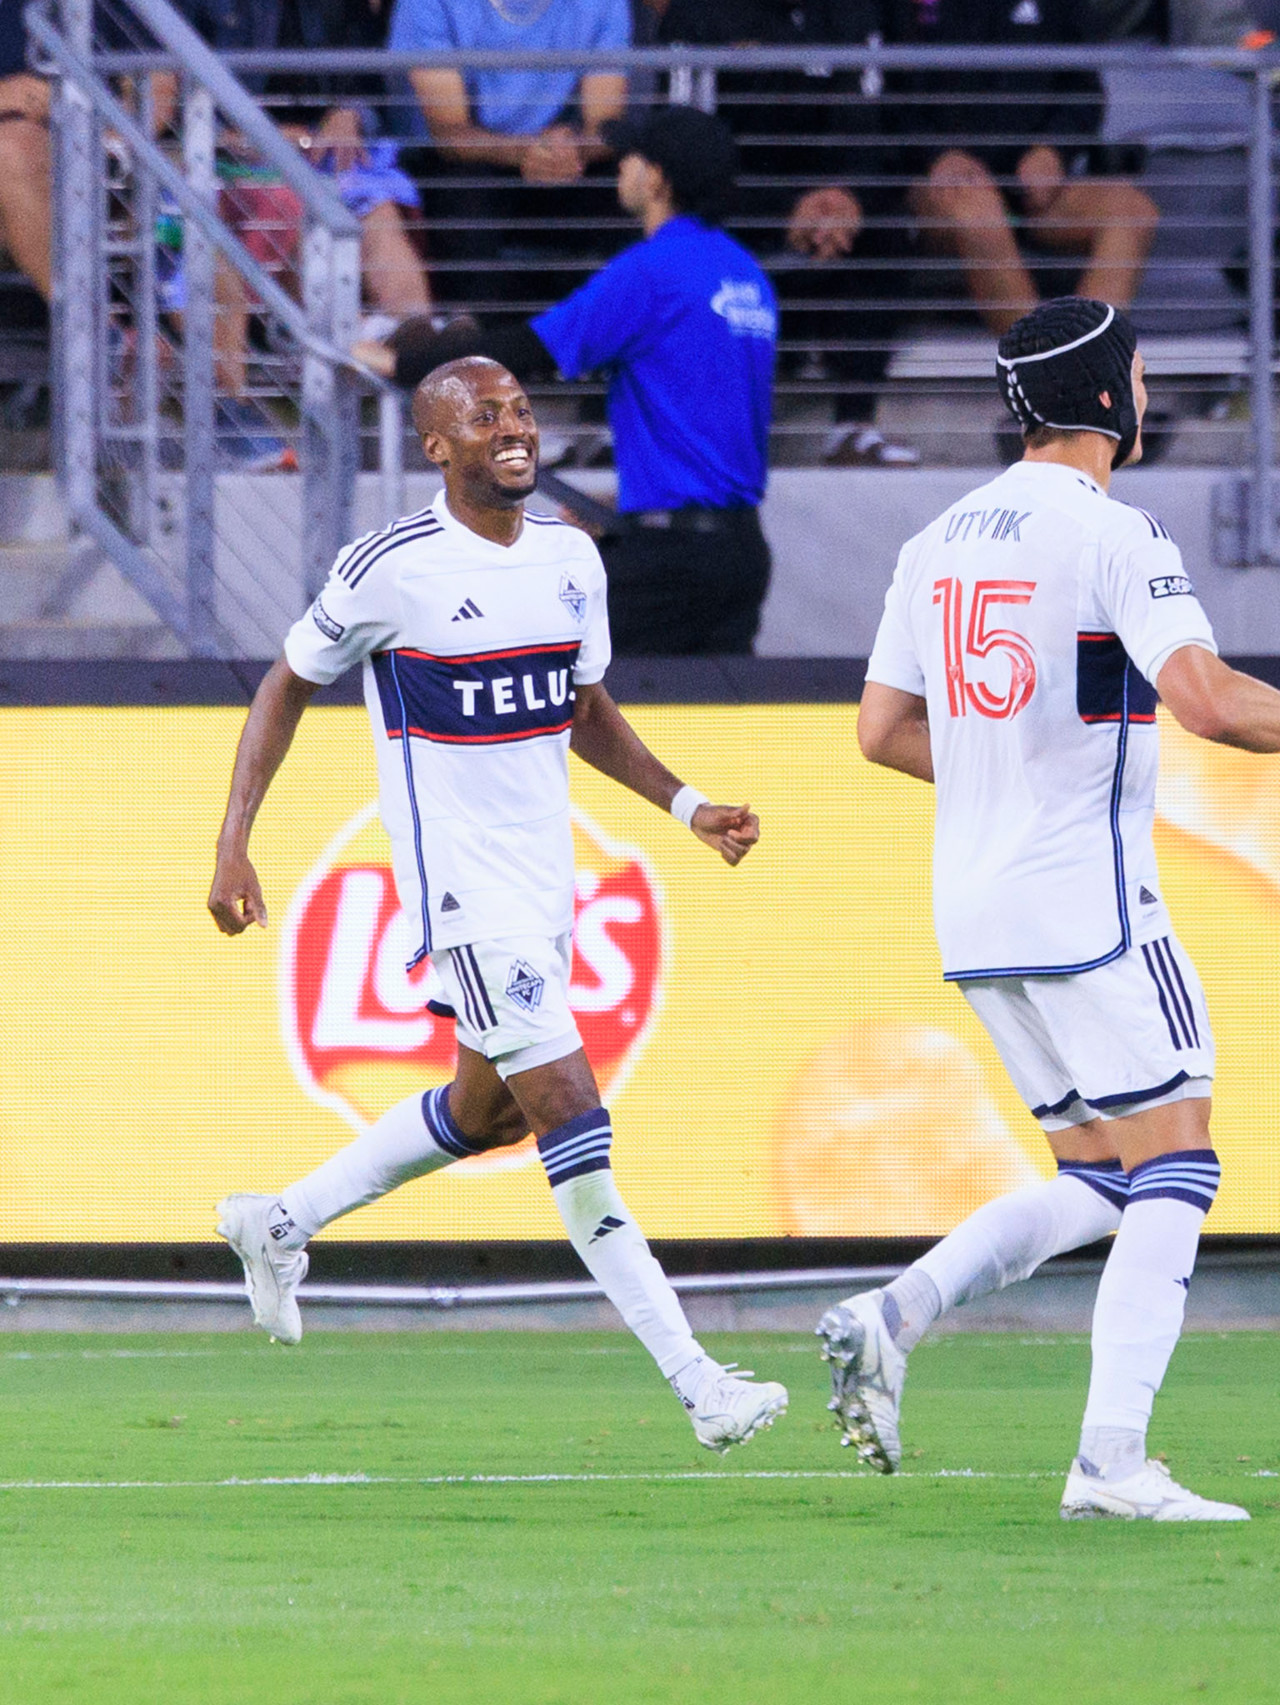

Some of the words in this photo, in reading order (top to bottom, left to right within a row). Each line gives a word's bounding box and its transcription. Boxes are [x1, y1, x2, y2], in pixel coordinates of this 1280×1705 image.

[944, 507, 1033, 543] UTVIK
[932, 577, 1037, 721] 15
[453, 668, 577, 717] TELU
